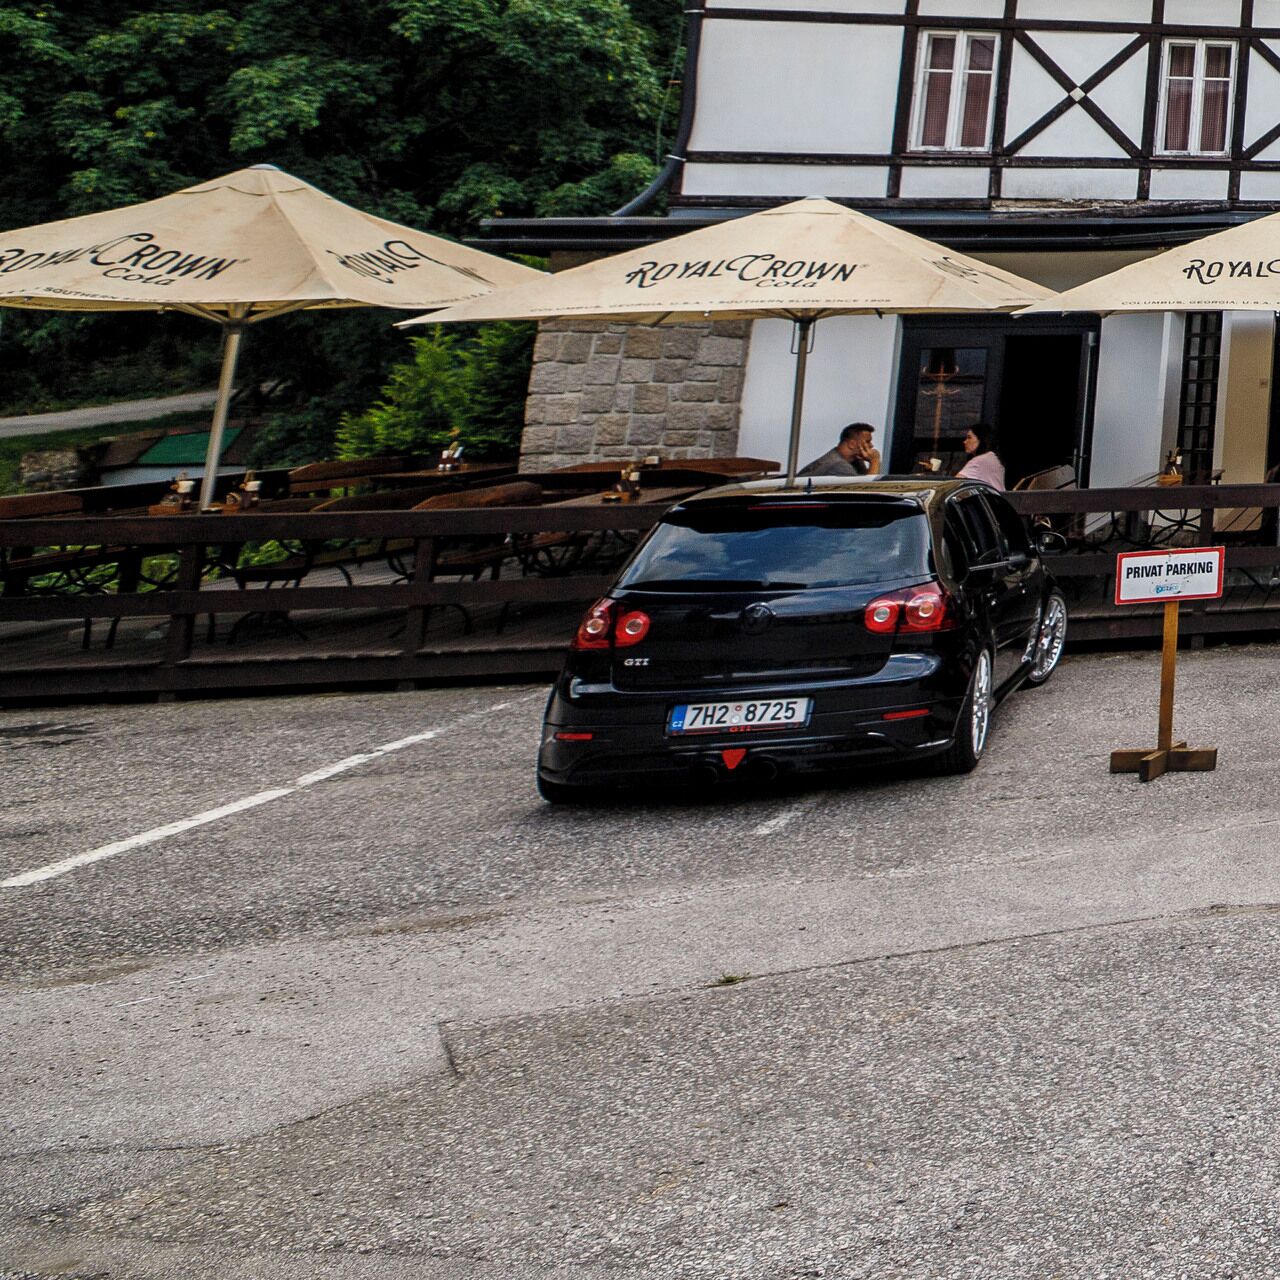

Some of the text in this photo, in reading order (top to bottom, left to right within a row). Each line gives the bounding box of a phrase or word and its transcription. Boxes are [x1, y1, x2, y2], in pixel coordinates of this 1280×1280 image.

[102, 268, 176, 285] Cola
[626, 254, 857, 288] ROYAL CROWN
[1183, 259, 1269, 285] ROYAL
[756, 278, 817, 288] Cola
[1126, 561, 1213, 579] PRIVAT PARKING
[624, 658, 650, 666] GTI
[689, 701, 797, 726] 7H2 8725
